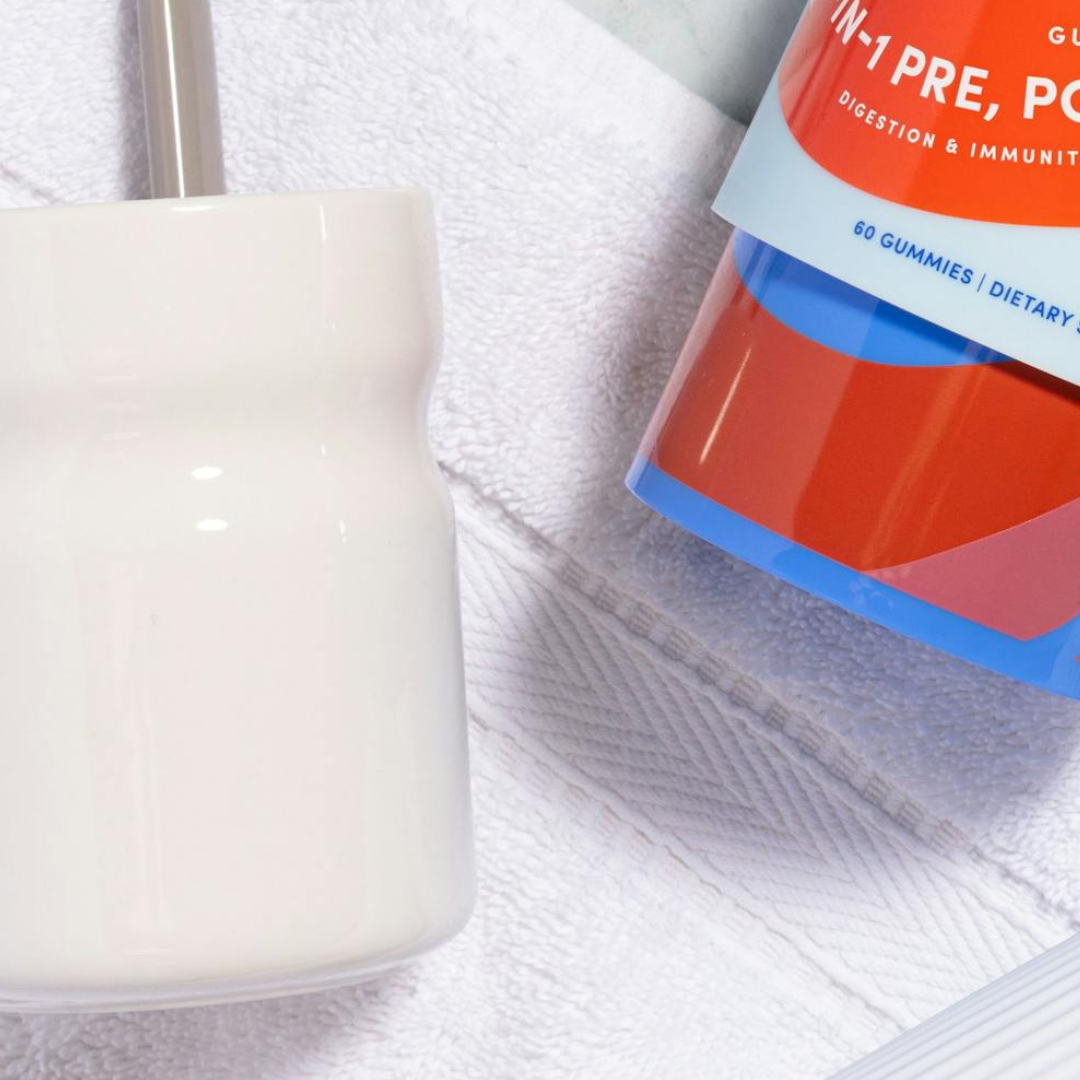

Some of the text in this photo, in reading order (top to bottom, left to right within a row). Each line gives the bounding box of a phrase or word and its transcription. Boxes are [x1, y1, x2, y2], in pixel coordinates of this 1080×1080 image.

[838, 90, 936, 149] DIGESTION
[945, 138, 958, 154] &
[890, 44, 1000, 122] PRE,
[852, 220, 876, 241] 60
[880, 232, 974, 286] GUMMIES
[988, 281, 1075, 328] DIETARY
